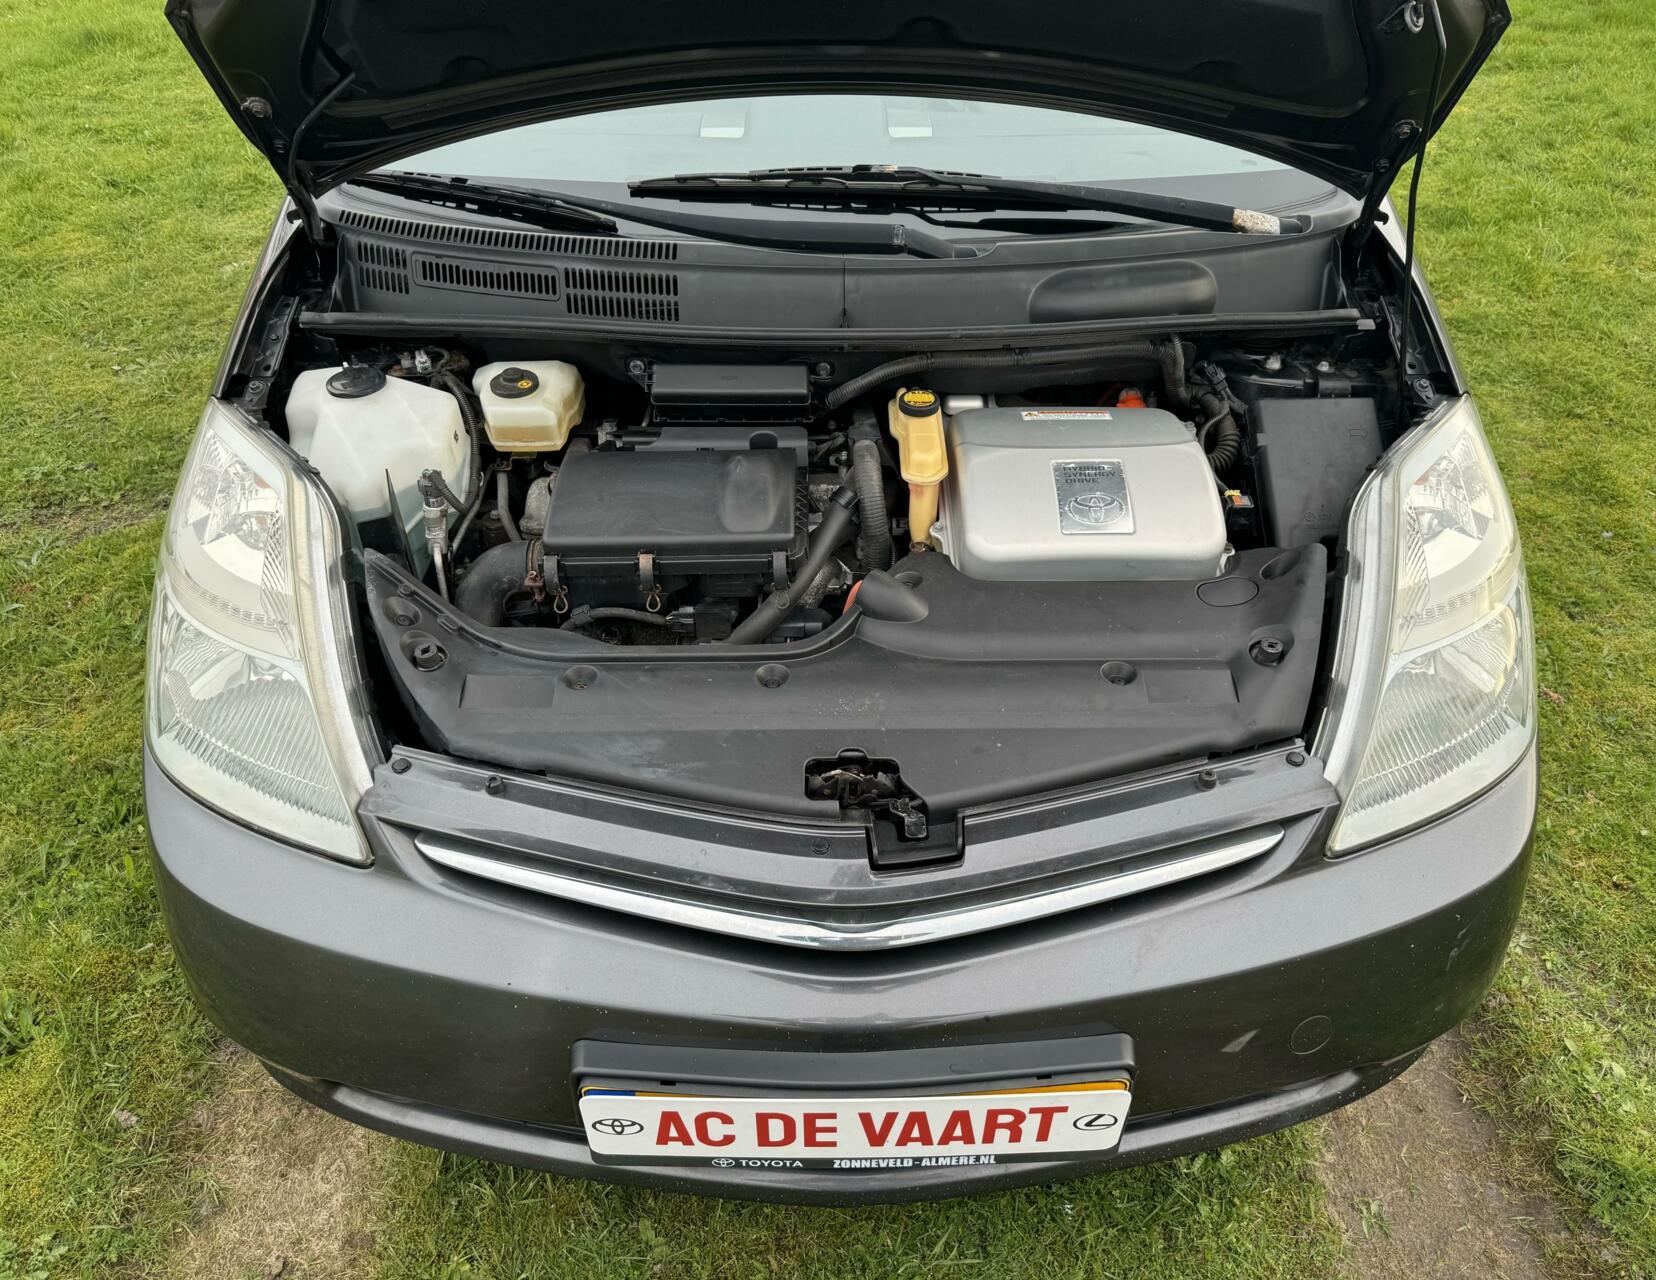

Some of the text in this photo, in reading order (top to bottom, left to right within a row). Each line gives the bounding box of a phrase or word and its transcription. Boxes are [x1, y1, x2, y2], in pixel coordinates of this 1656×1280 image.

[656, 1105, 1069, 1148] AC DE VAART
[739, 1159, 804, 1168] TOYOTA
[833, 1154, 997, 1169] ZONNEVELD-ALMERE.NL
